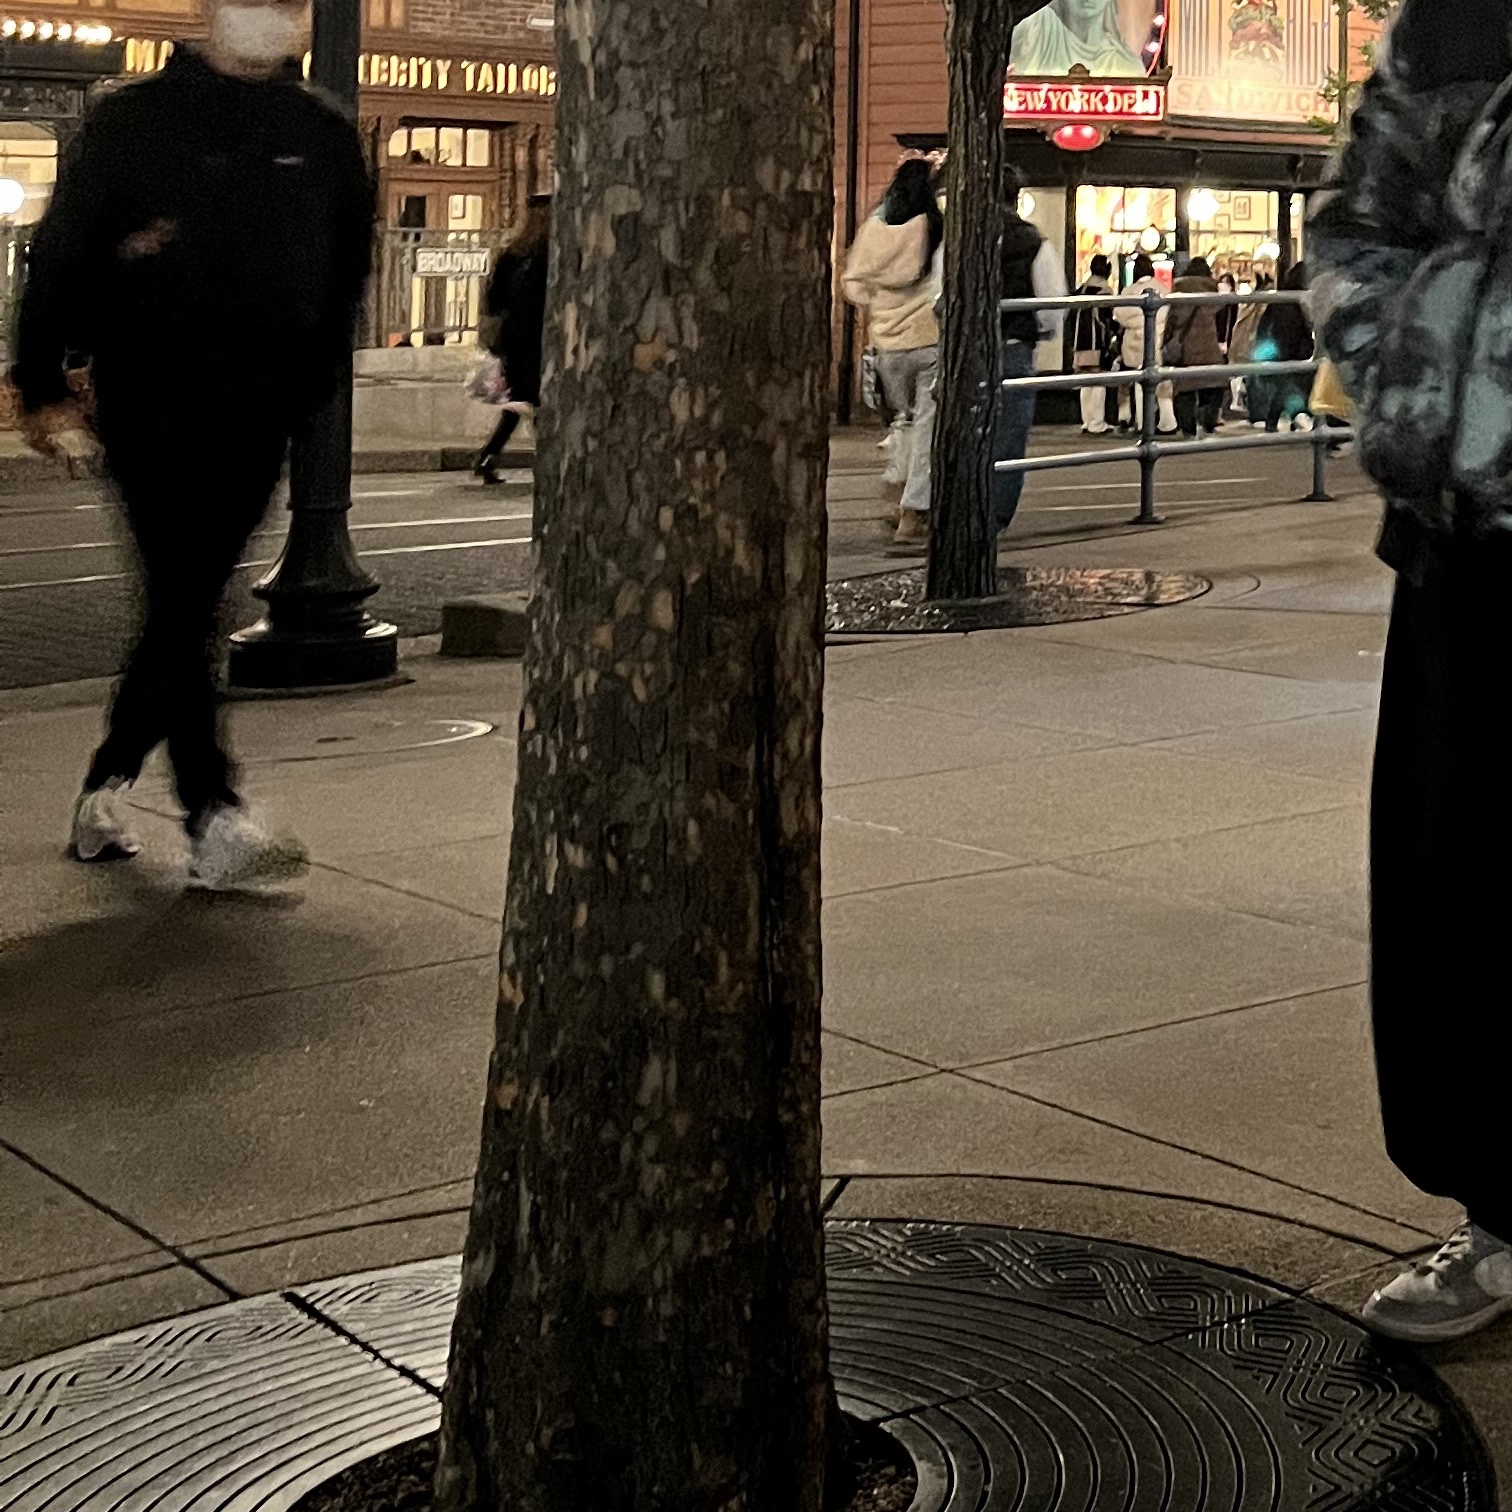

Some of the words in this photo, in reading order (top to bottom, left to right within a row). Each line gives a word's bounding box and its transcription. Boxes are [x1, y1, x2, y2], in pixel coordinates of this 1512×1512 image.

[1003, 89, 1047, 113] NEW
[1048, 90, 1106, 114] YORK
[1106, 92, 1158, 116] DELI
